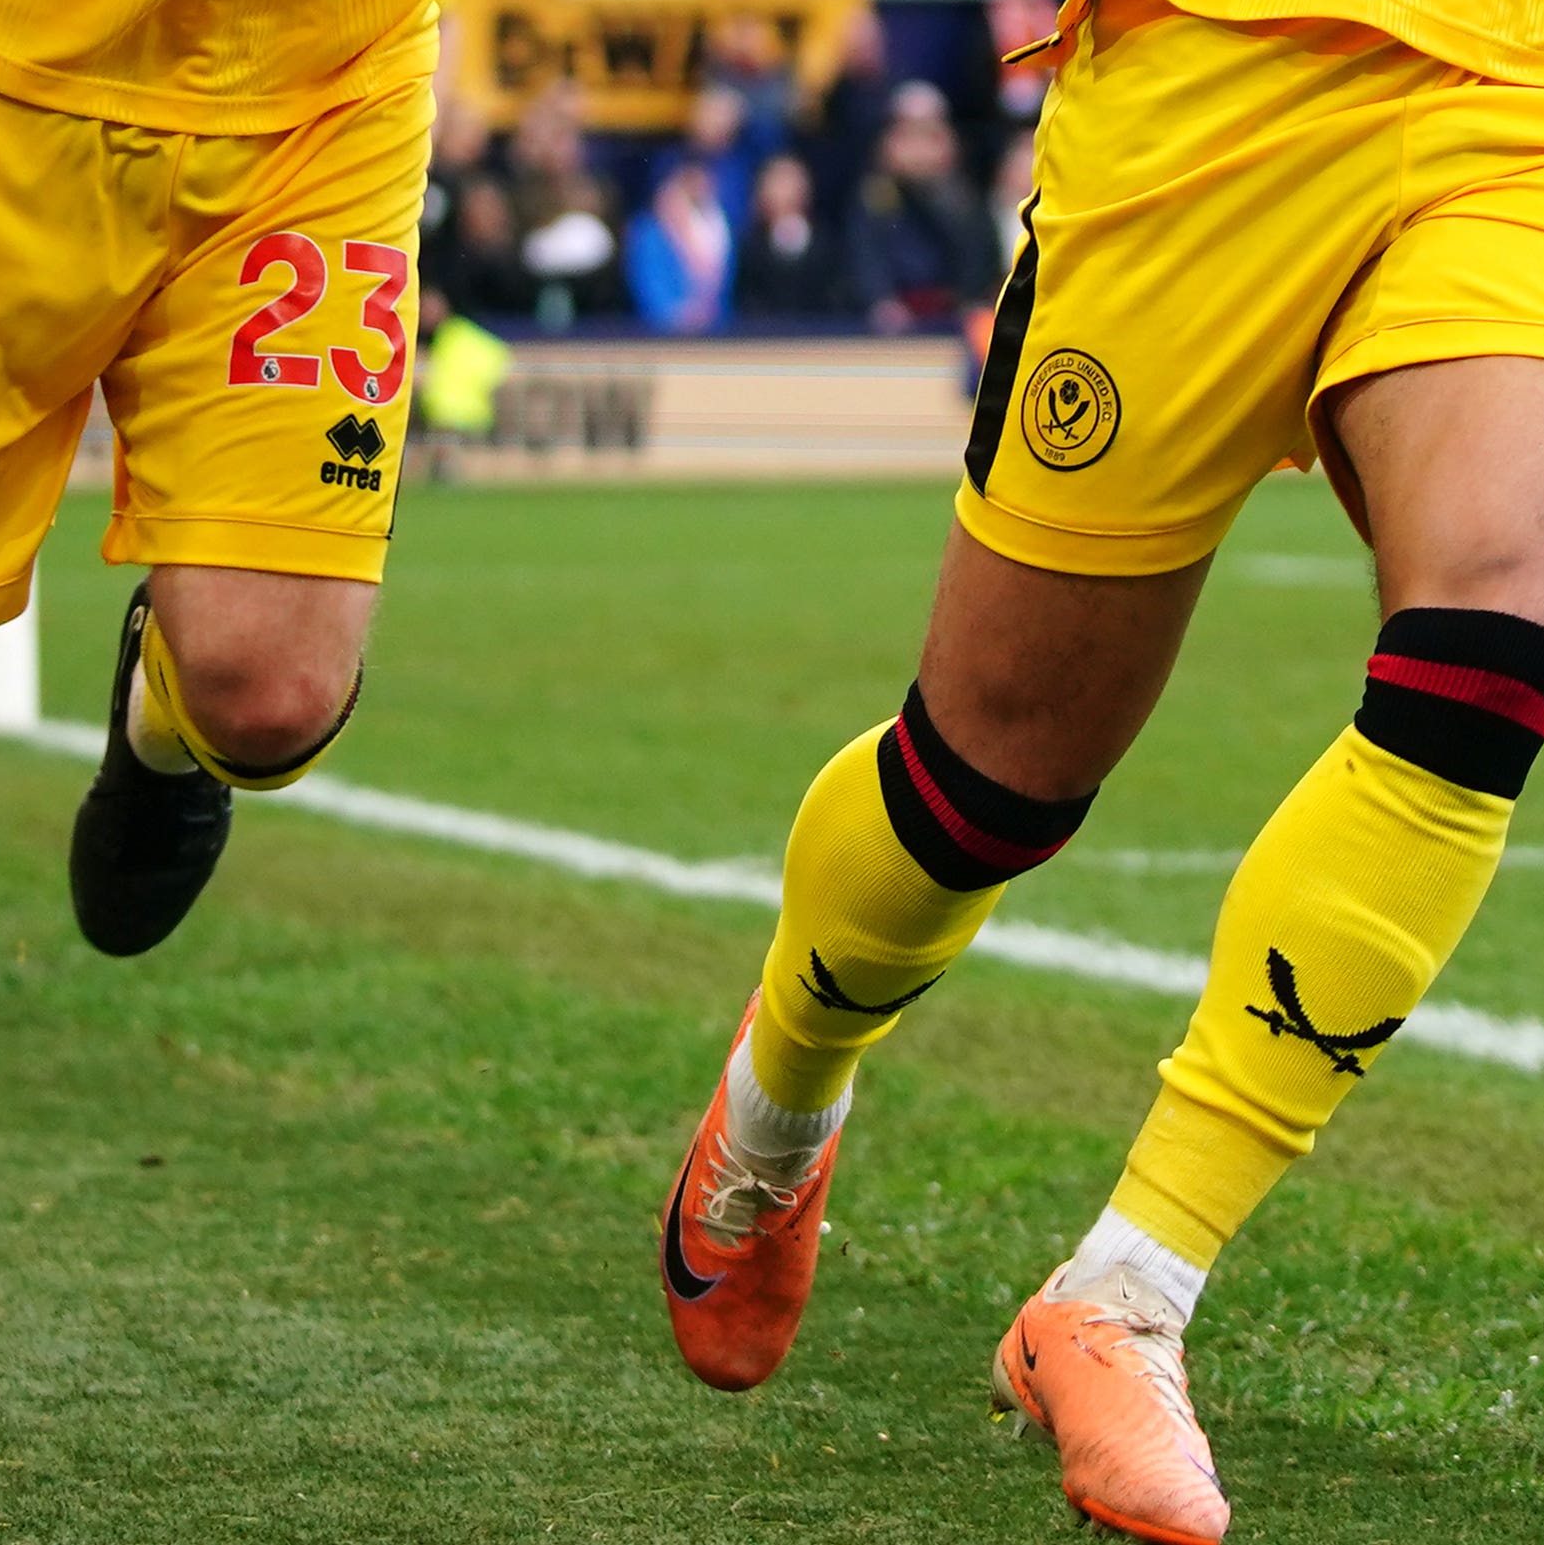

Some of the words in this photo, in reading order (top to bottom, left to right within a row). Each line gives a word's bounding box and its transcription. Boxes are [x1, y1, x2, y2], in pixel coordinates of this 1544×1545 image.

[227, 230, 409, 407] 23
[1030, 357, 1075, 398] SHEFFIELD
[1077, 360, 1110, 397] UNITED
[320, 460, 382, 492] errea
